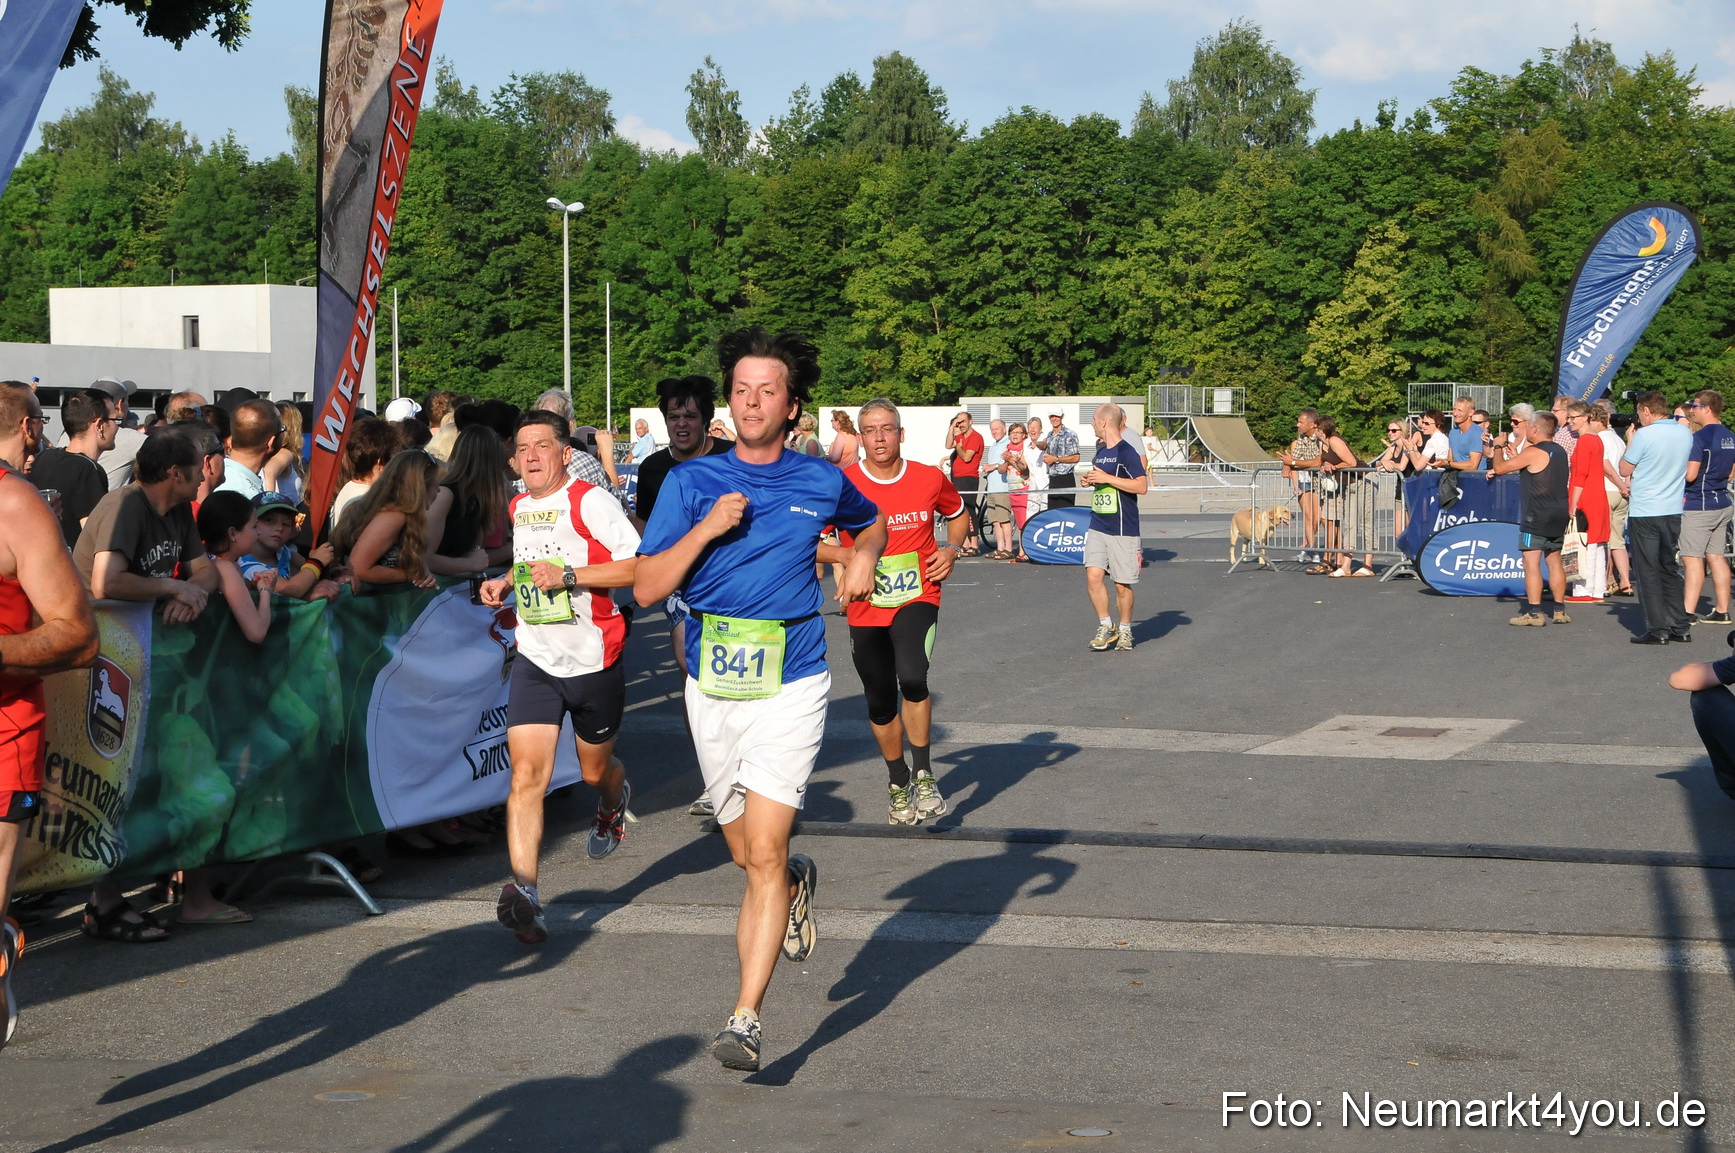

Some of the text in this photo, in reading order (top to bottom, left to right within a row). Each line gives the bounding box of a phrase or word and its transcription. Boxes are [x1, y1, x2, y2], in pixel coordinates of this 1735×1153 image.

[1629, 279, 1654, 307] Druck
[1566, 259, 1659, 369] Frischmann
[1094, 494, 1112, 506] 333
[531, 525, 555, 533] Germany
[1433, 510, 1497, 532] Fisch
[711, 644, 766, 678] 841
[94, 728, 116, 750] 1628
